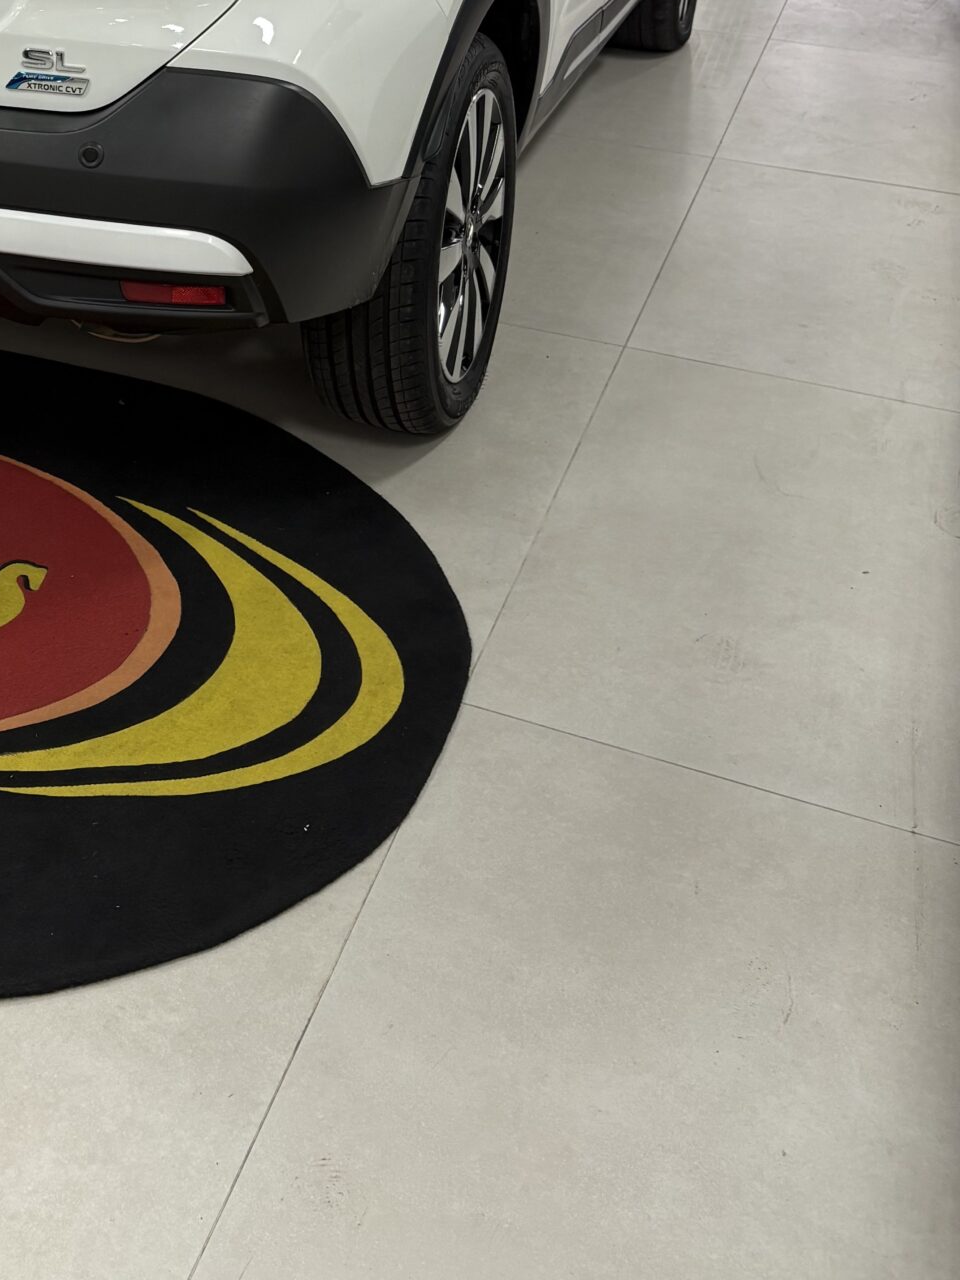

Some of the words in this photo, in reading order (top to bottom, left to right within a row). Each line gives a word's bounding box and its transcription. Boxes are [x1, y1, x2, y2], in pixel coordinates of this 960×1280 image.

[21, 47, 86, 73] SL
[26, 82, 63, 93] XTRONIC
[65, 86, 83, 94] CVT
